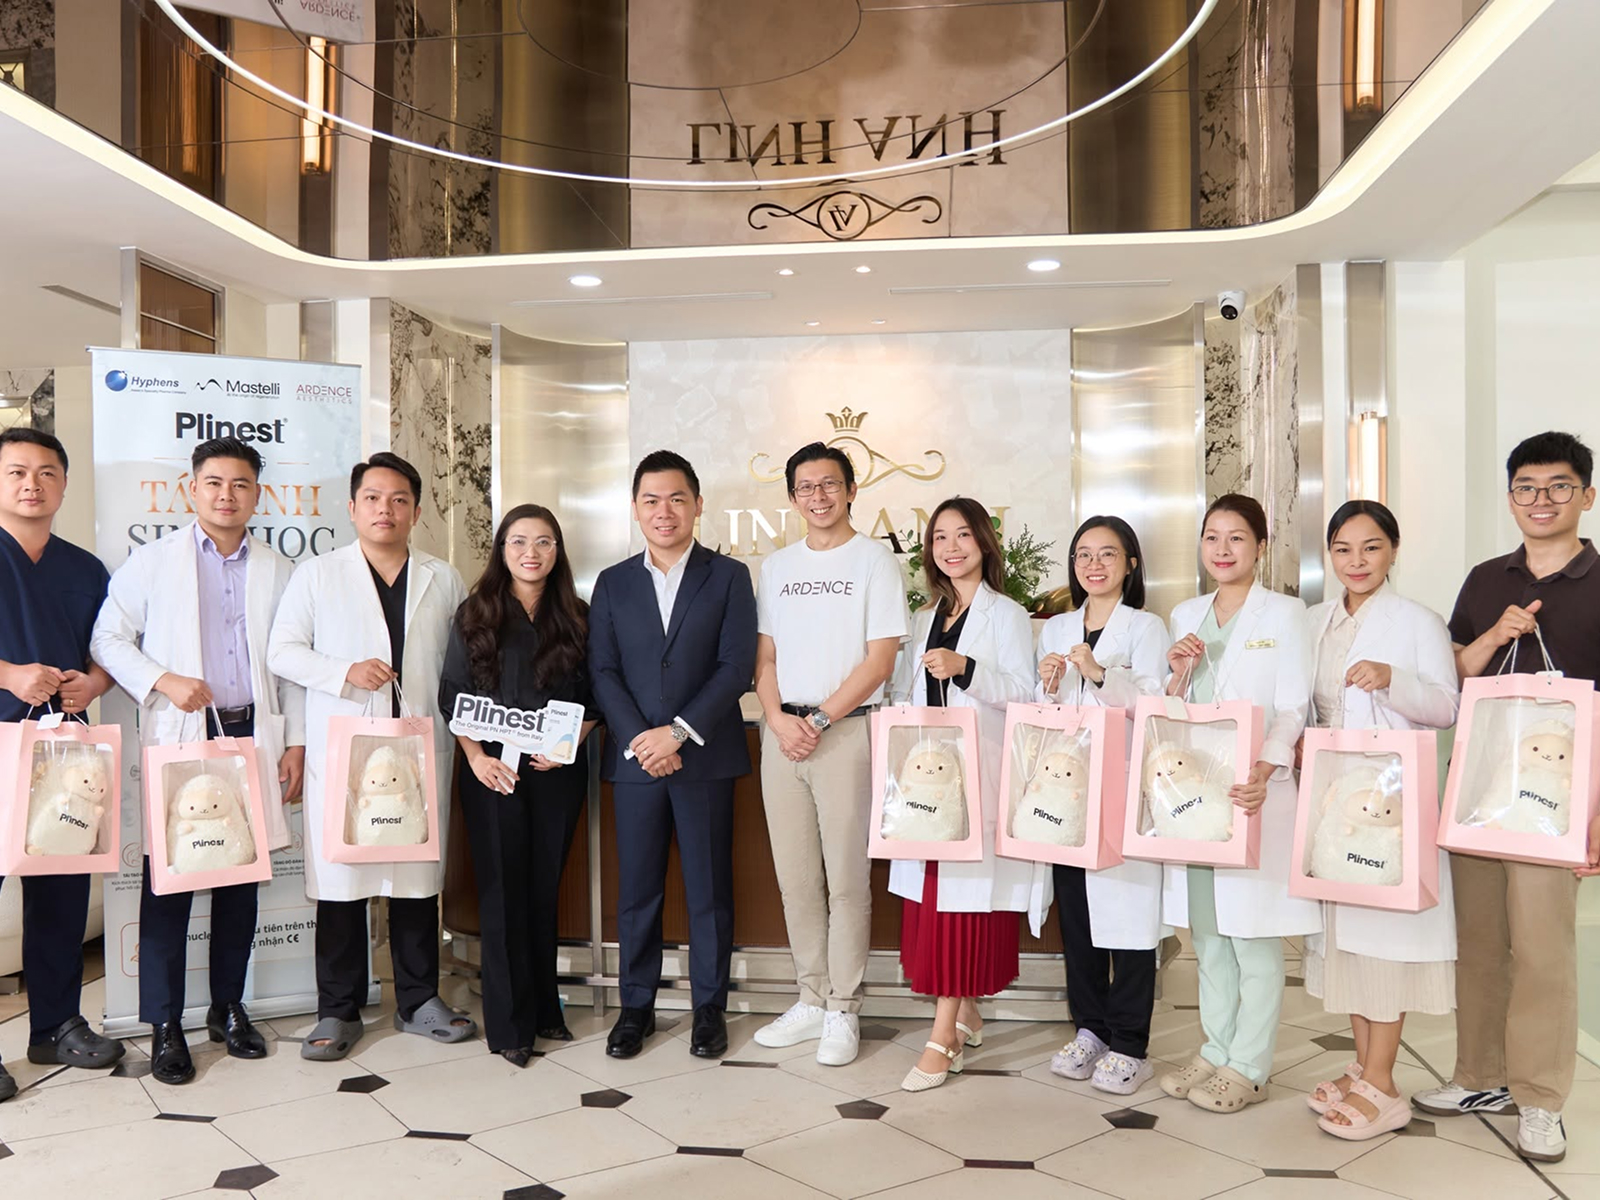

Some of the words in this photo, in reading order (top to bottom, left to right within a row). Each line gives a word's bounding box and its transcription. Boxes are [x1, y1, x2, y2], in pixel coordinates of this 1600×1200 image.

[131, 376, 180, 388] Hyphens
[226, 379, 280, 395] Mastelli
[296, 384, 352, 397] ARDENCE
[140, 472, 198, 514] TÁ
[779, 580, 854, 597] ARDENCE
[457, 696, 547, 734] Plinest
[466, 722, 489, 731] Original
[285, 920, 304, 931] trên
[259, 936, 284, 948] nhận
